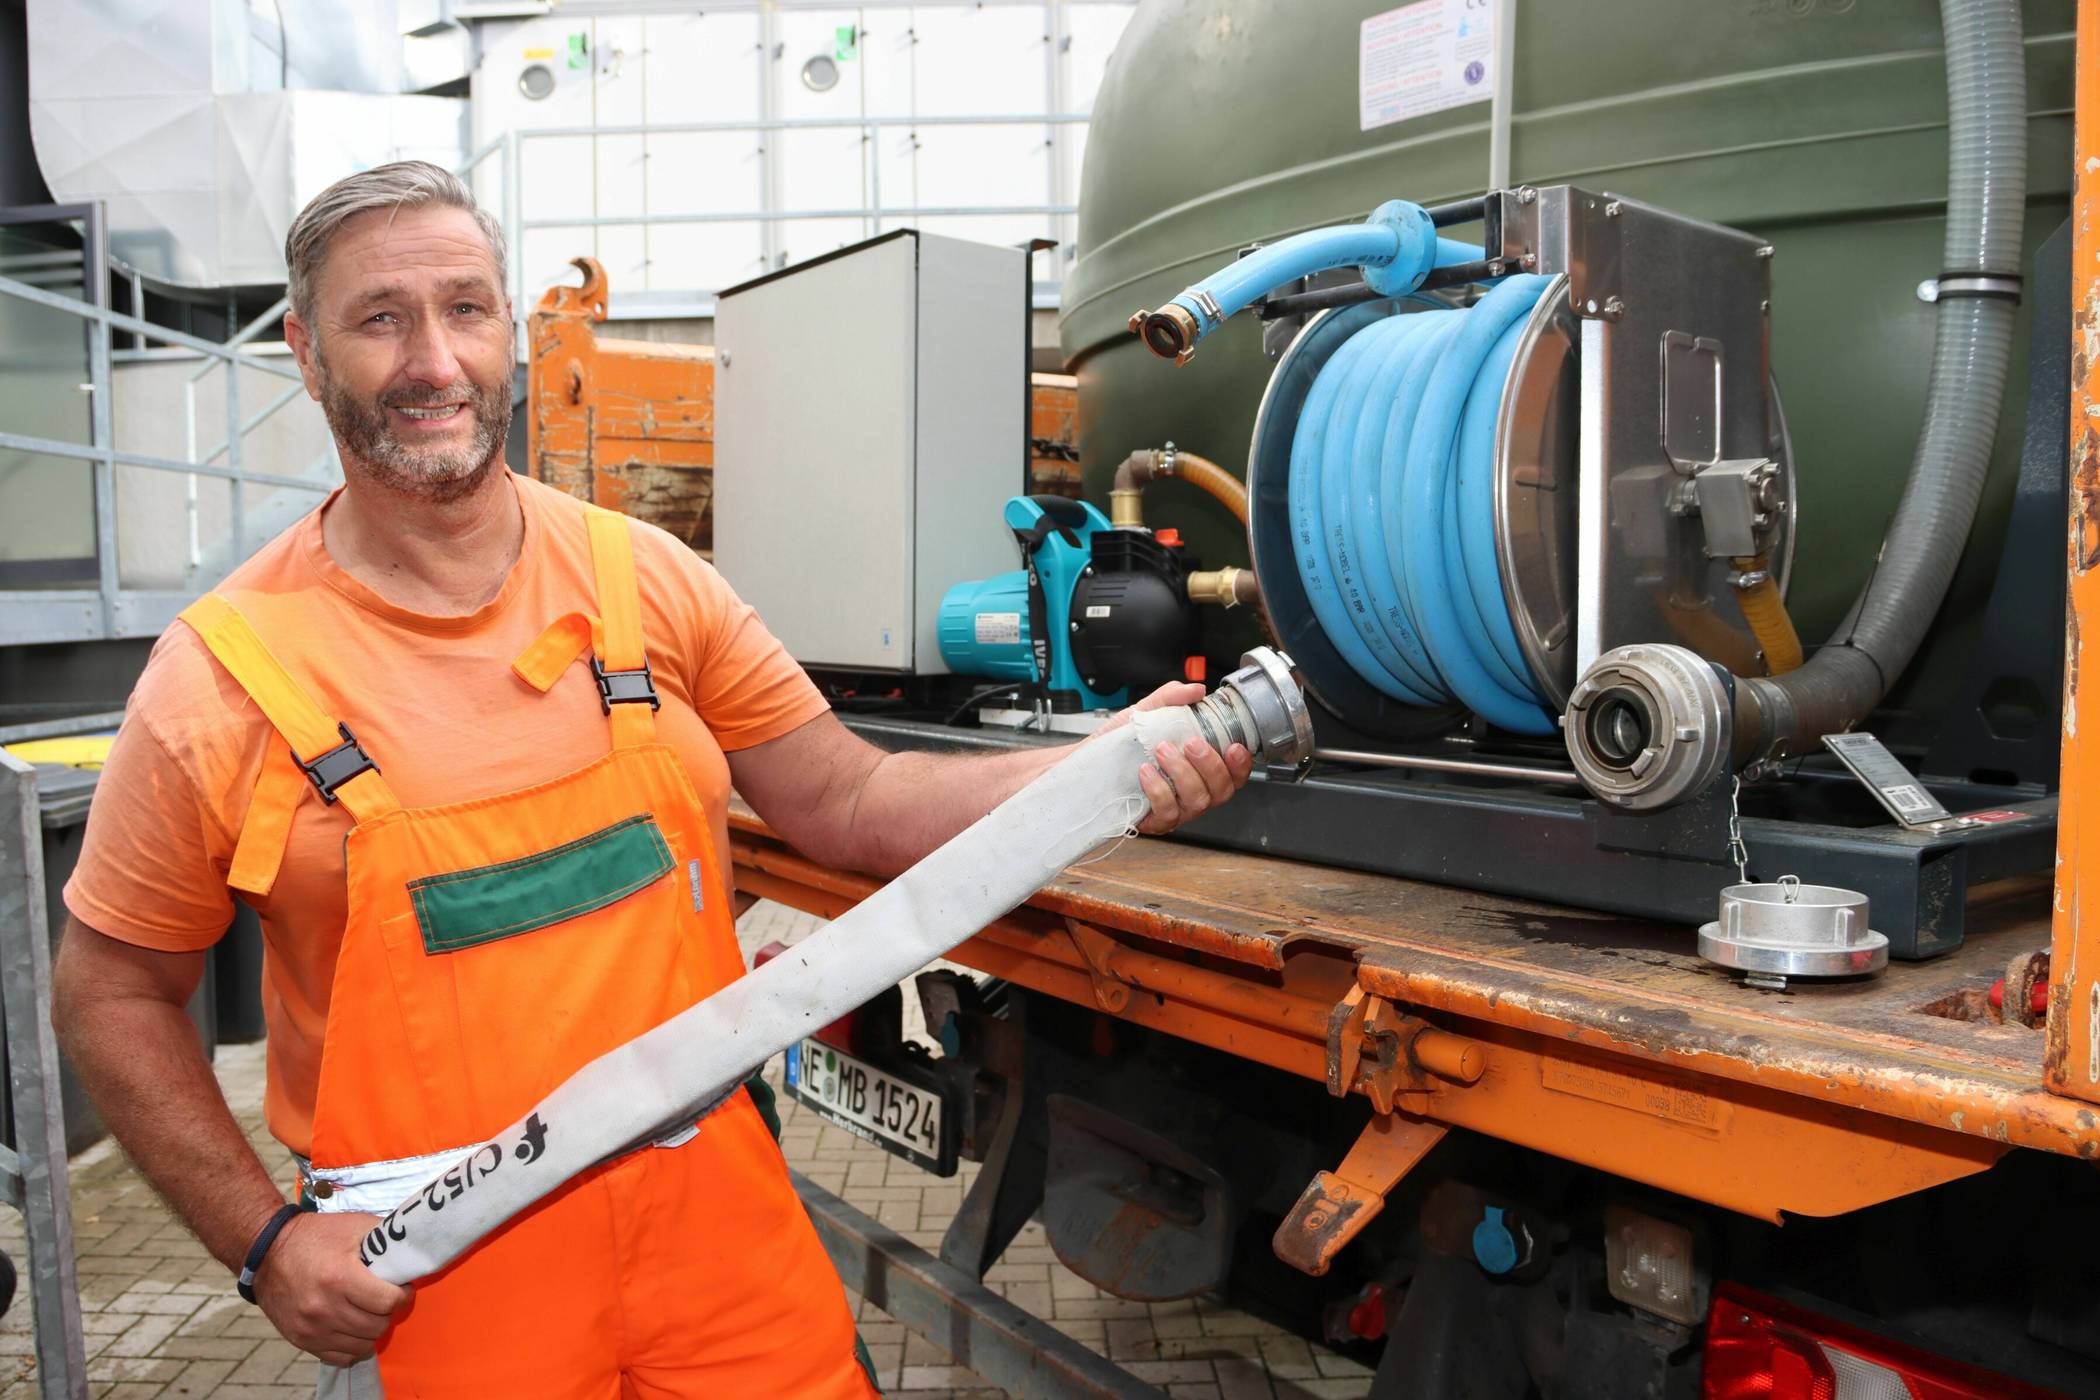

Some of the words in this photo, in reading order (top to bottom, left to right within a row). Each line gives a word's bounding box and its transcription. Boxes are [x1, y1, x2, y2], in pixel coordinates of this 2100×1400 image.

[799, 1044, 821, 1093] NE
[838, 1061, 867, 1115] MB
[873, 1079, 935, 1149] 1524
